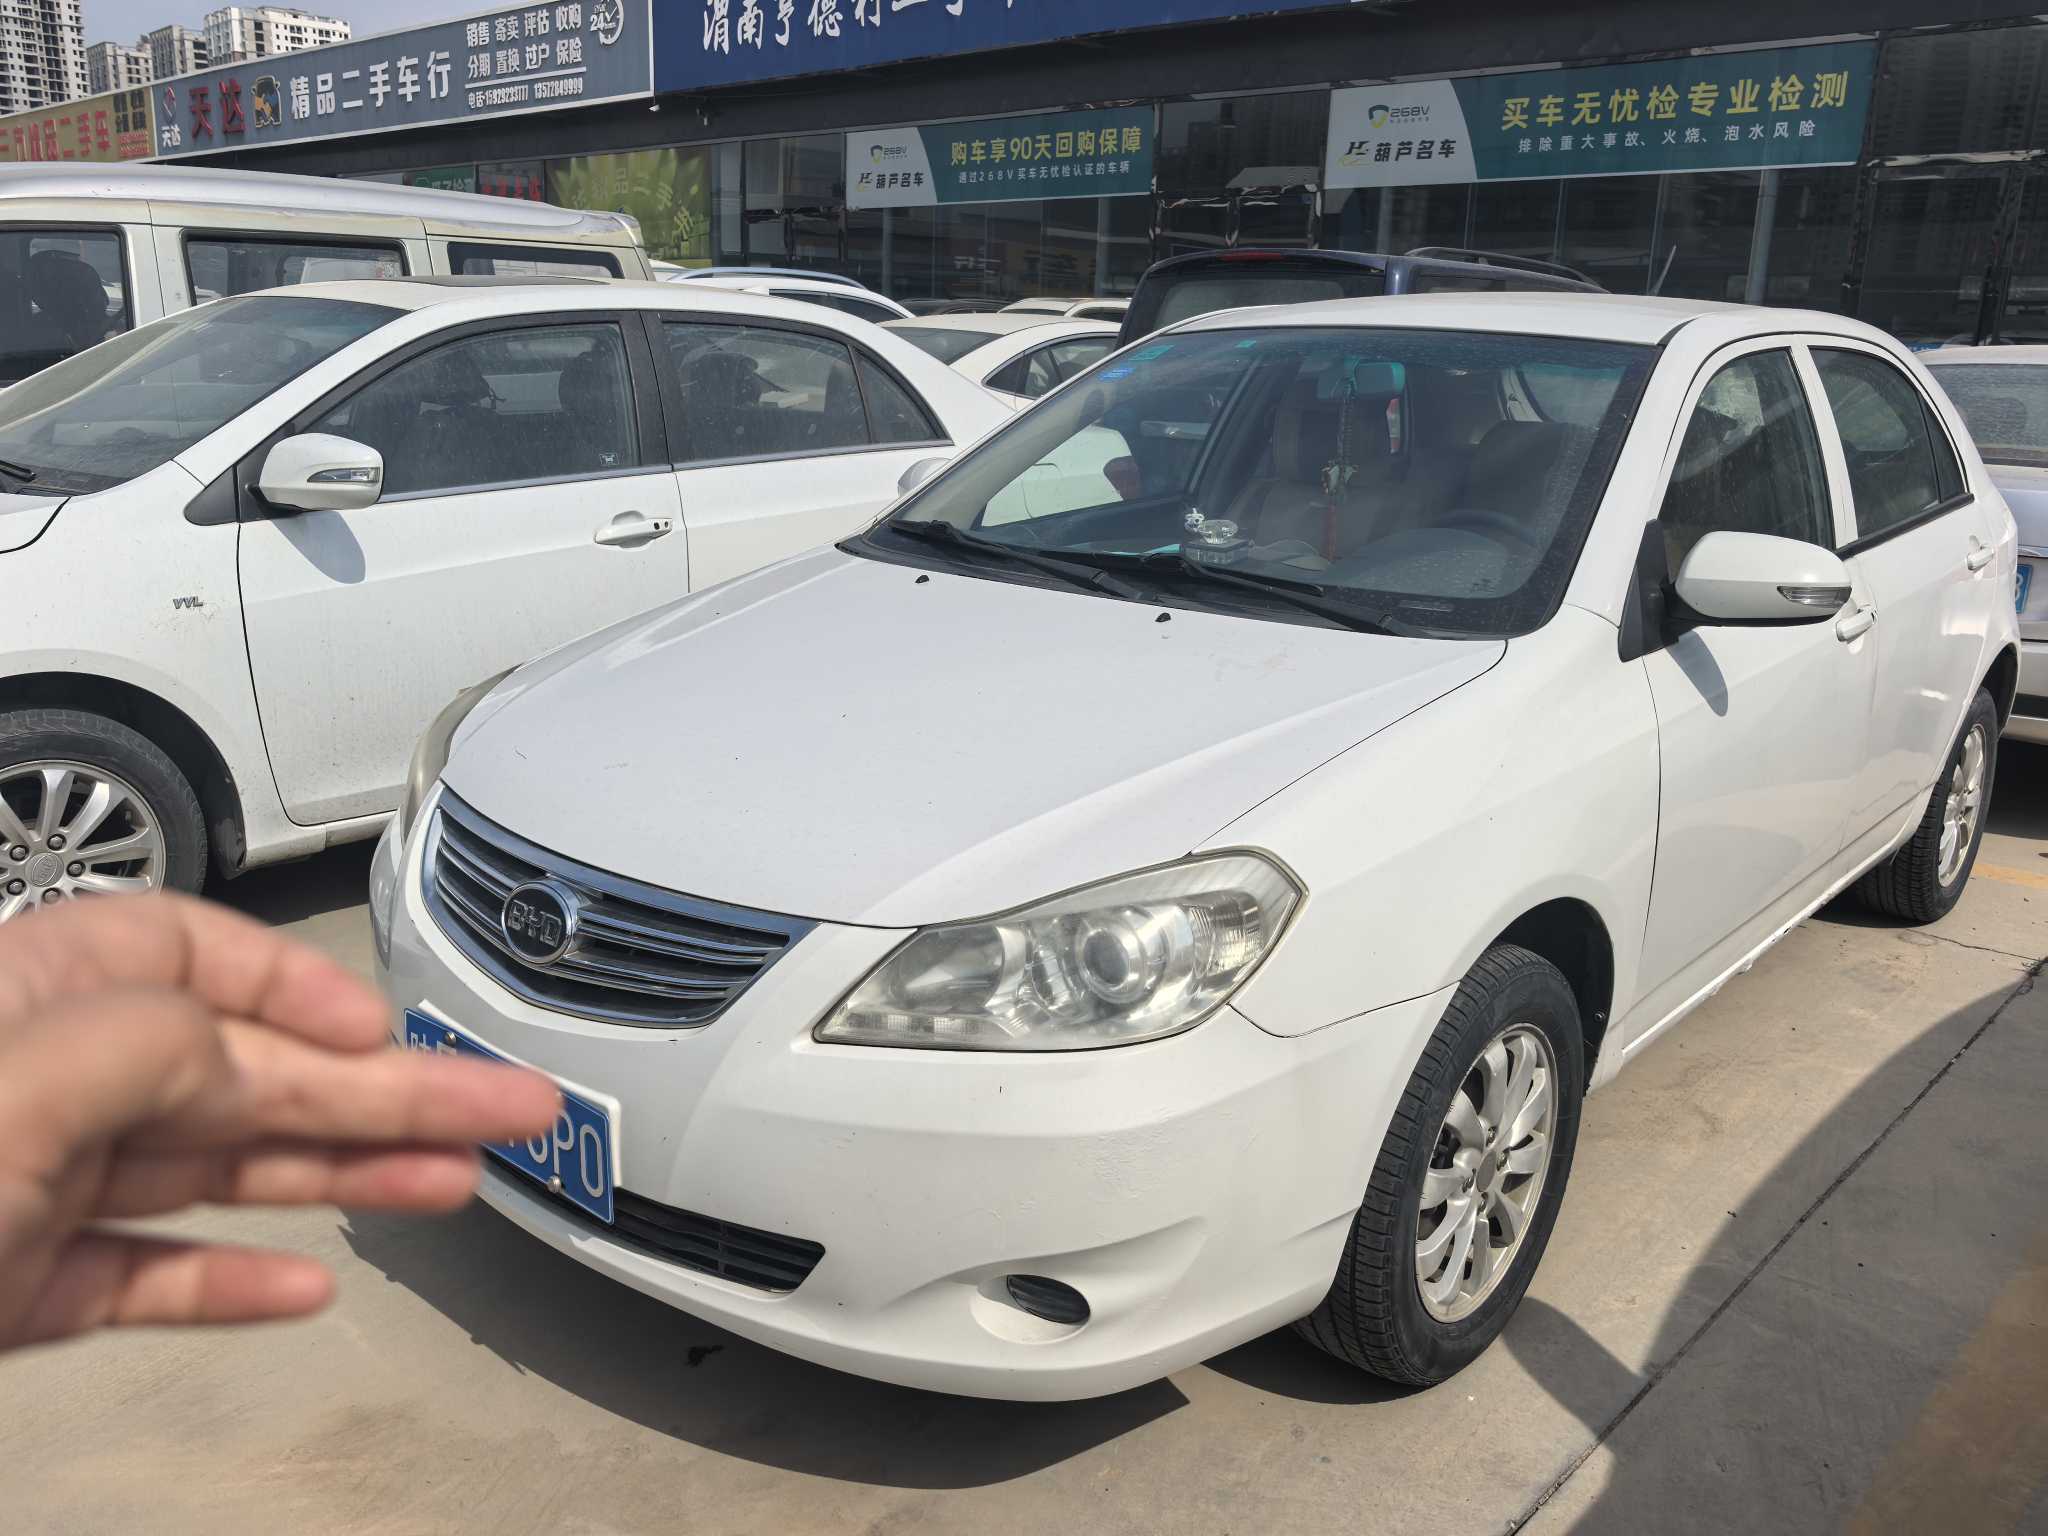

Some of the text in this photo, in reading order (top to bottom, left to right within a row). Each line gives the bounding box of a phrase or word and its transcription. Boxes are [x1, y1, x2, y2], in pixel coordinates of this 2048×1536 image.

[466, 3, 582, 48] 销售 寄卖 评估 收购
[468, 37, 582, 79] 分期 置换 过户 保险
[189, 79, 245, 138] 天达
[290, 51, 452, 120] 精品二手车行
[1390, 104, 1430, 118] 268V
[1501, 70, 1849, 131] 买车无忧检专业检测
[951, 126, 1142, 167] 购车享90天回购保障
[1374, 138, 1457, 163] 葫芦名车
[875, 171, 924, 190] 葫芦名车
